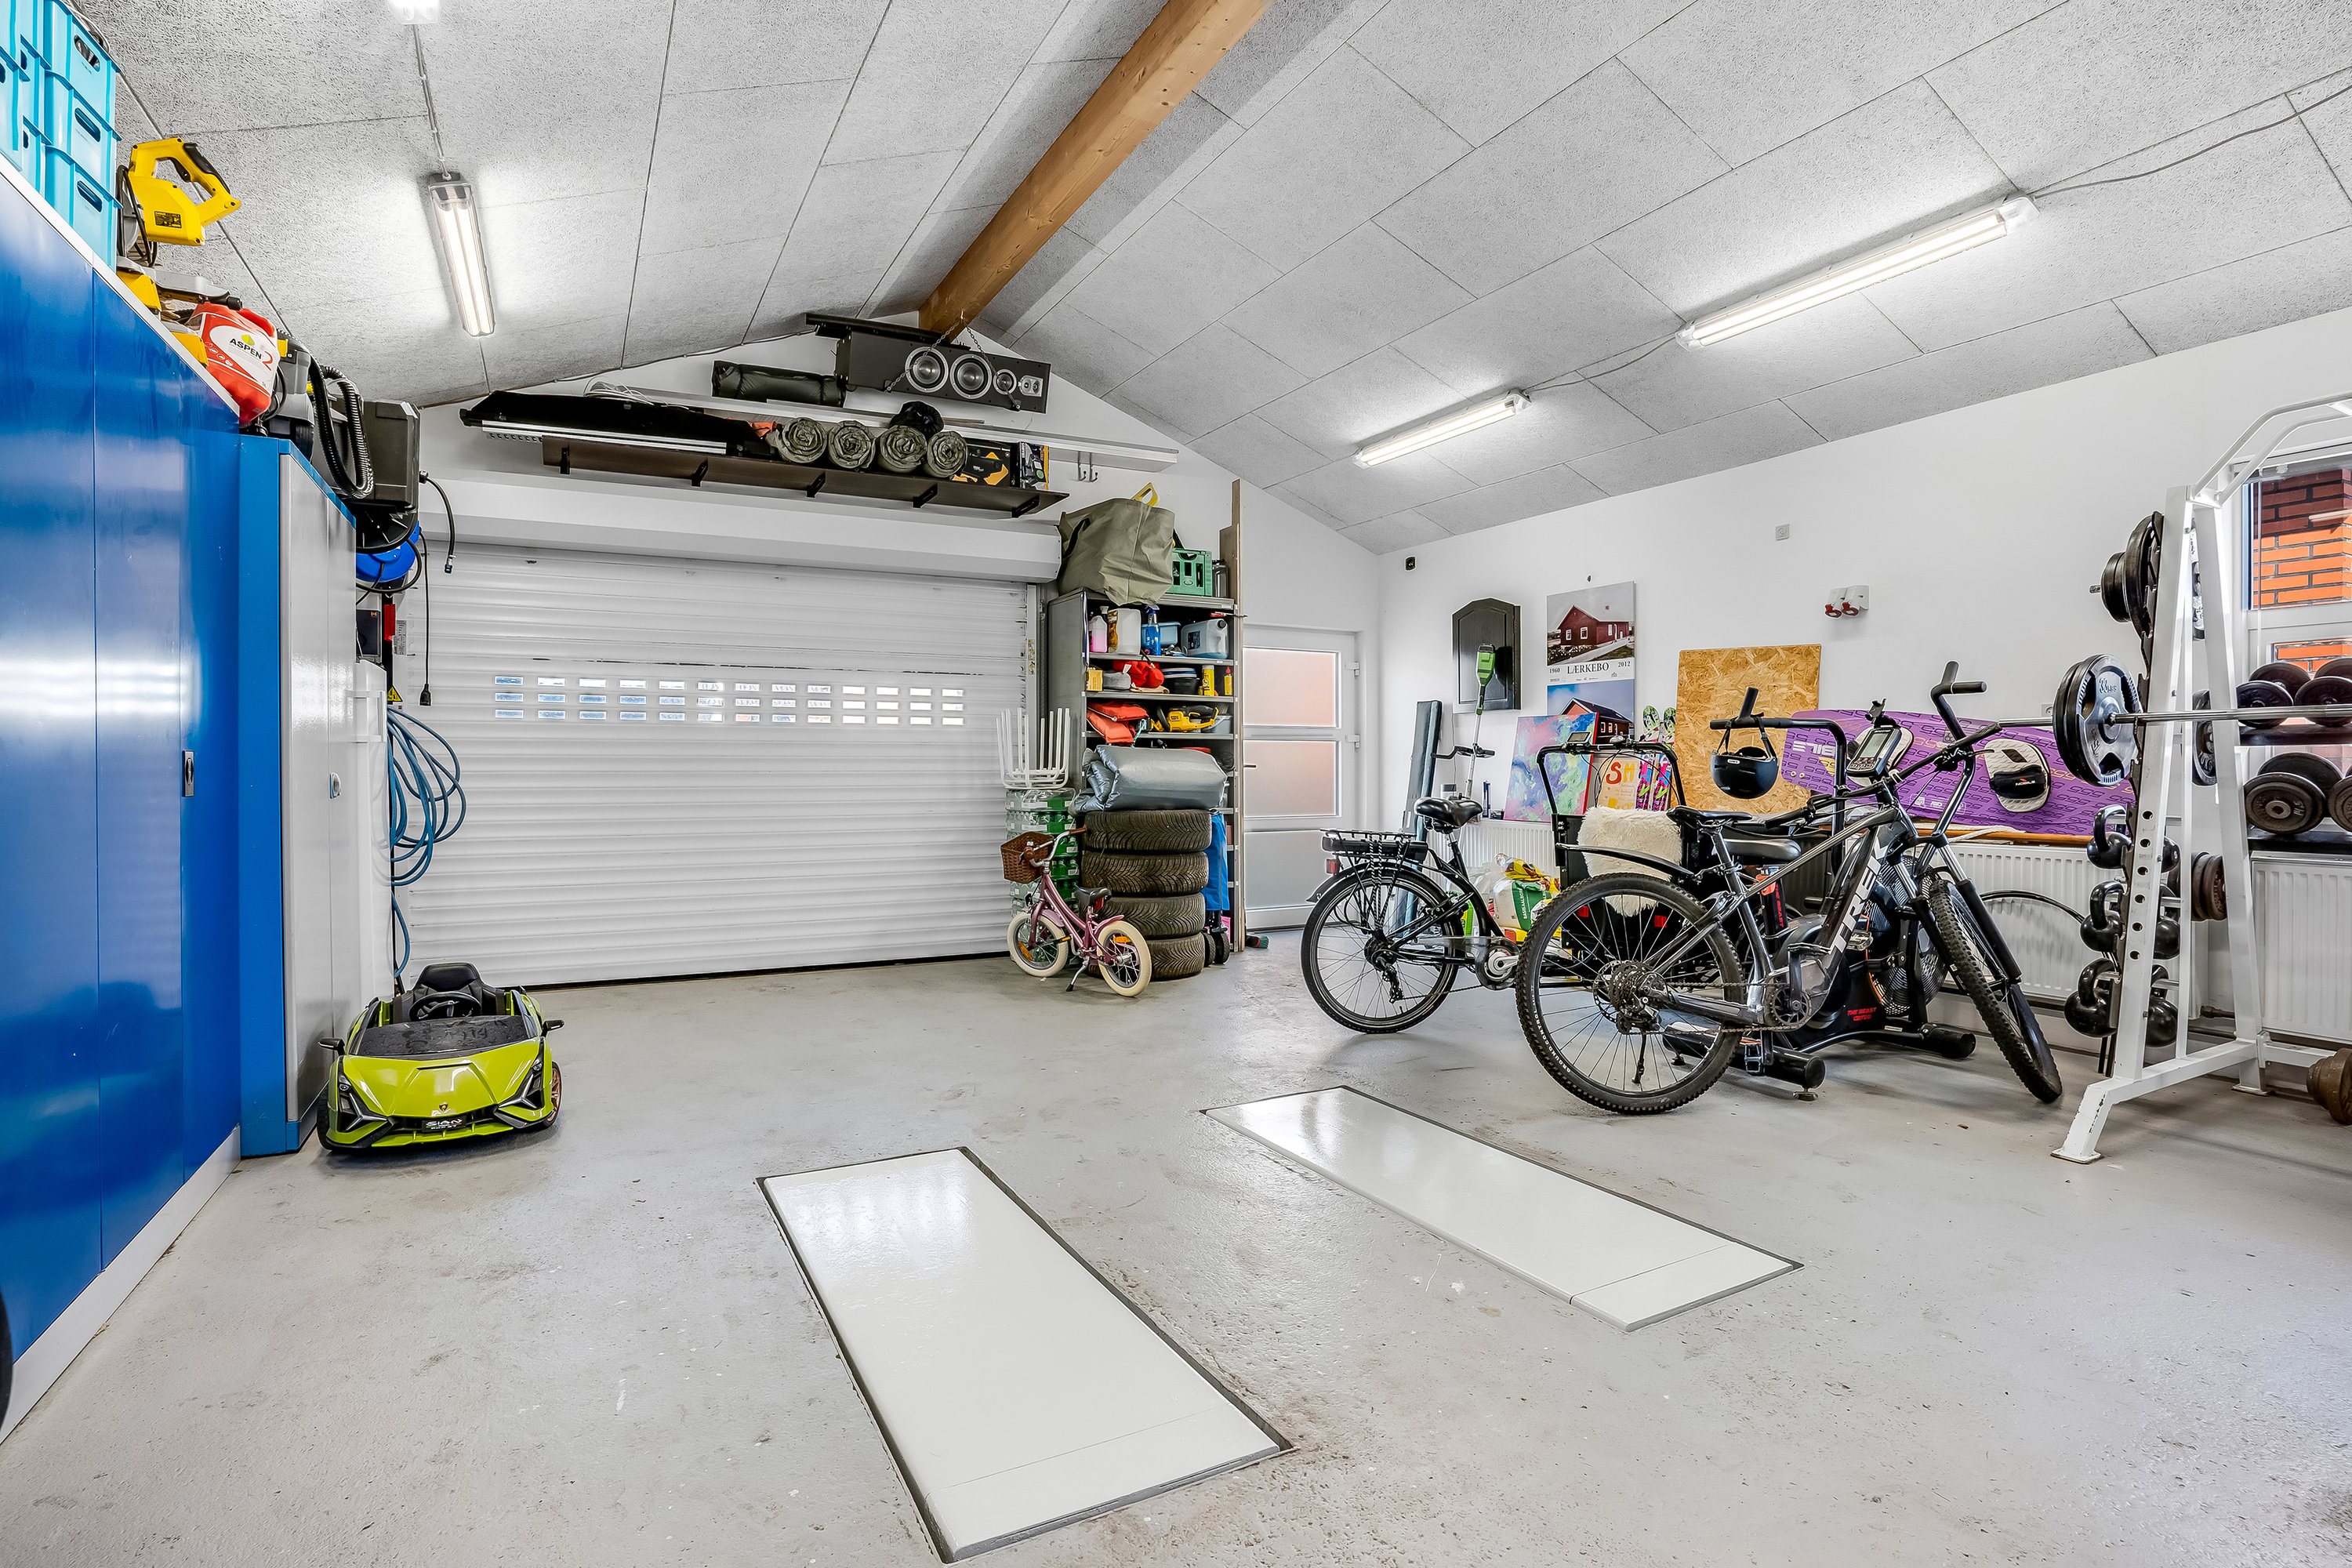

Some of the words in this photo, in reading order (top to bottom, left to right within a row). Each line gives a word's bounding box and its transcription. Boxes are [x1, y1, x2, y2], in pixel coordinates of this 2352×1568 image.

[230, 338, 262, 360] ASPEN
[262, 350, 274, 372] 2
[1567, 662, 1610, 674] LÆRKEBO
[1792, 741, 1836, 757] BILE
[1831, 827, 1889, 953] TREK
[1534, 1010, 1550, 1045] CONTROL
